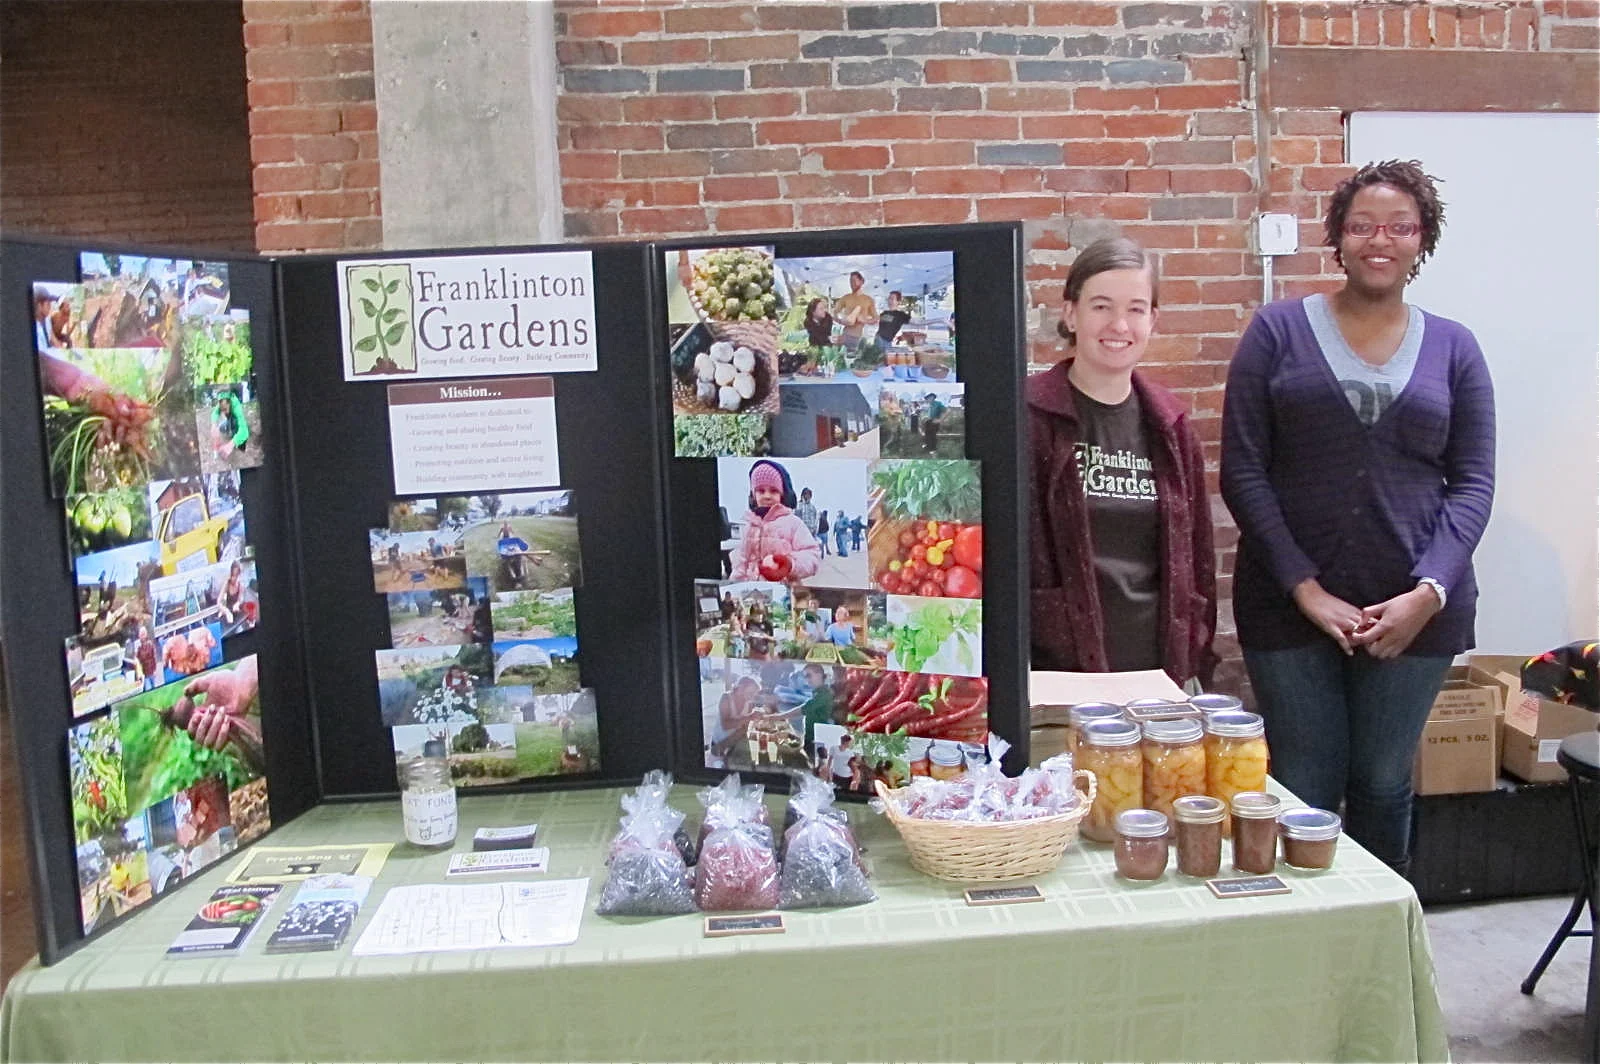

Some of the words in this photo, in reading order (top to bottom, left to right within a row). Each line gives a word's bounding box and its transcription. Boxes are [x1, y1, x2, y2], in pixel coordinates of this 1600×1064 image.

[417, 267, 585, 302] Franklinton
[418, 303, 588, 351] Gardens
[439, 386, 502, 399] Mission...
